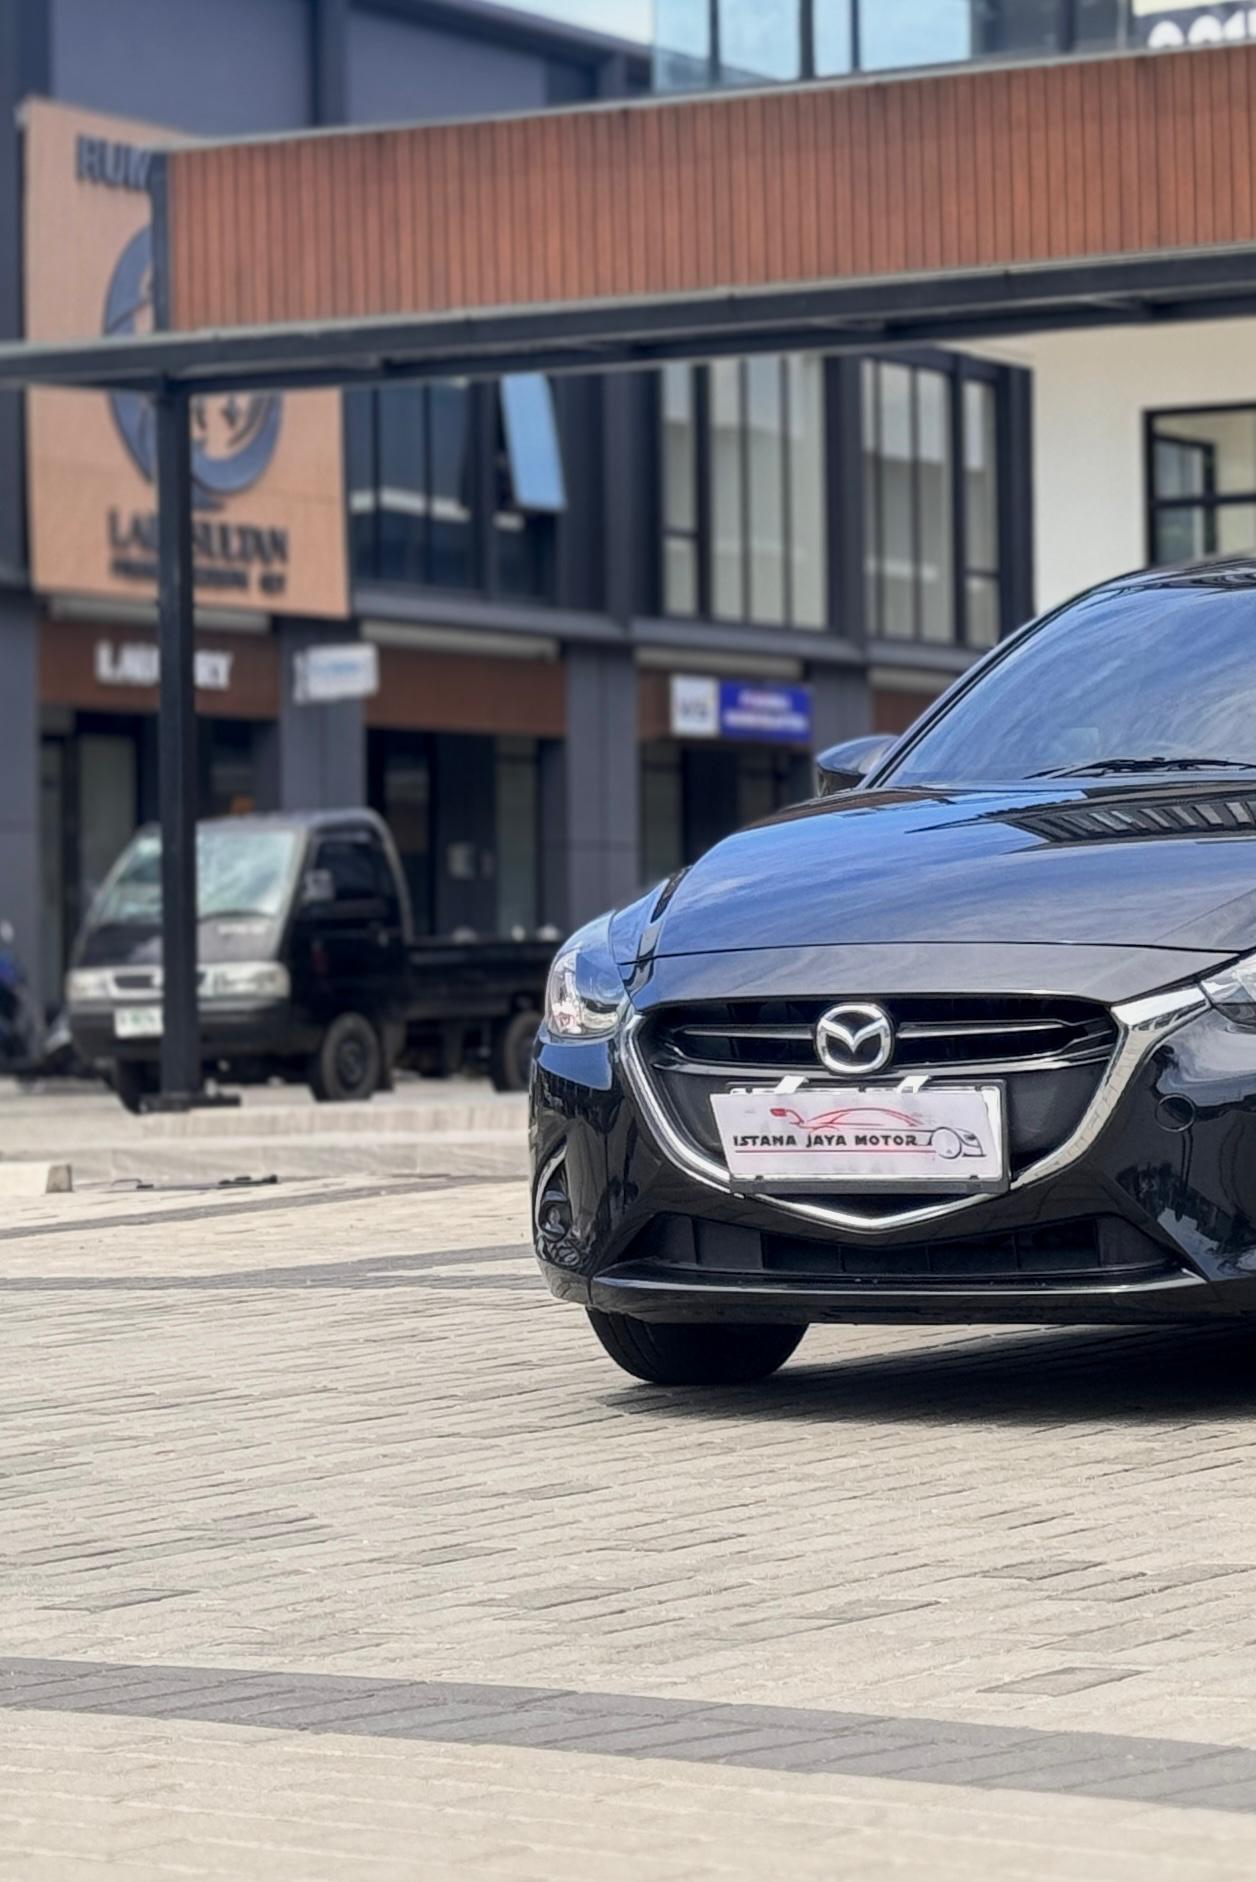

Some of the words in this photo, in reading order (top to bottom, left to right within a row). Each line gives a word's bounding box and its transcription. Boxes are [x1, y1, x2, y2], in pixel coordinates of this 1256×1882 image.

[733, 1135, 797, 1147] ISTANA
[805, 1135, 847, 1148] JAYA
[855, 1134, 918, 1147] MOTOR
